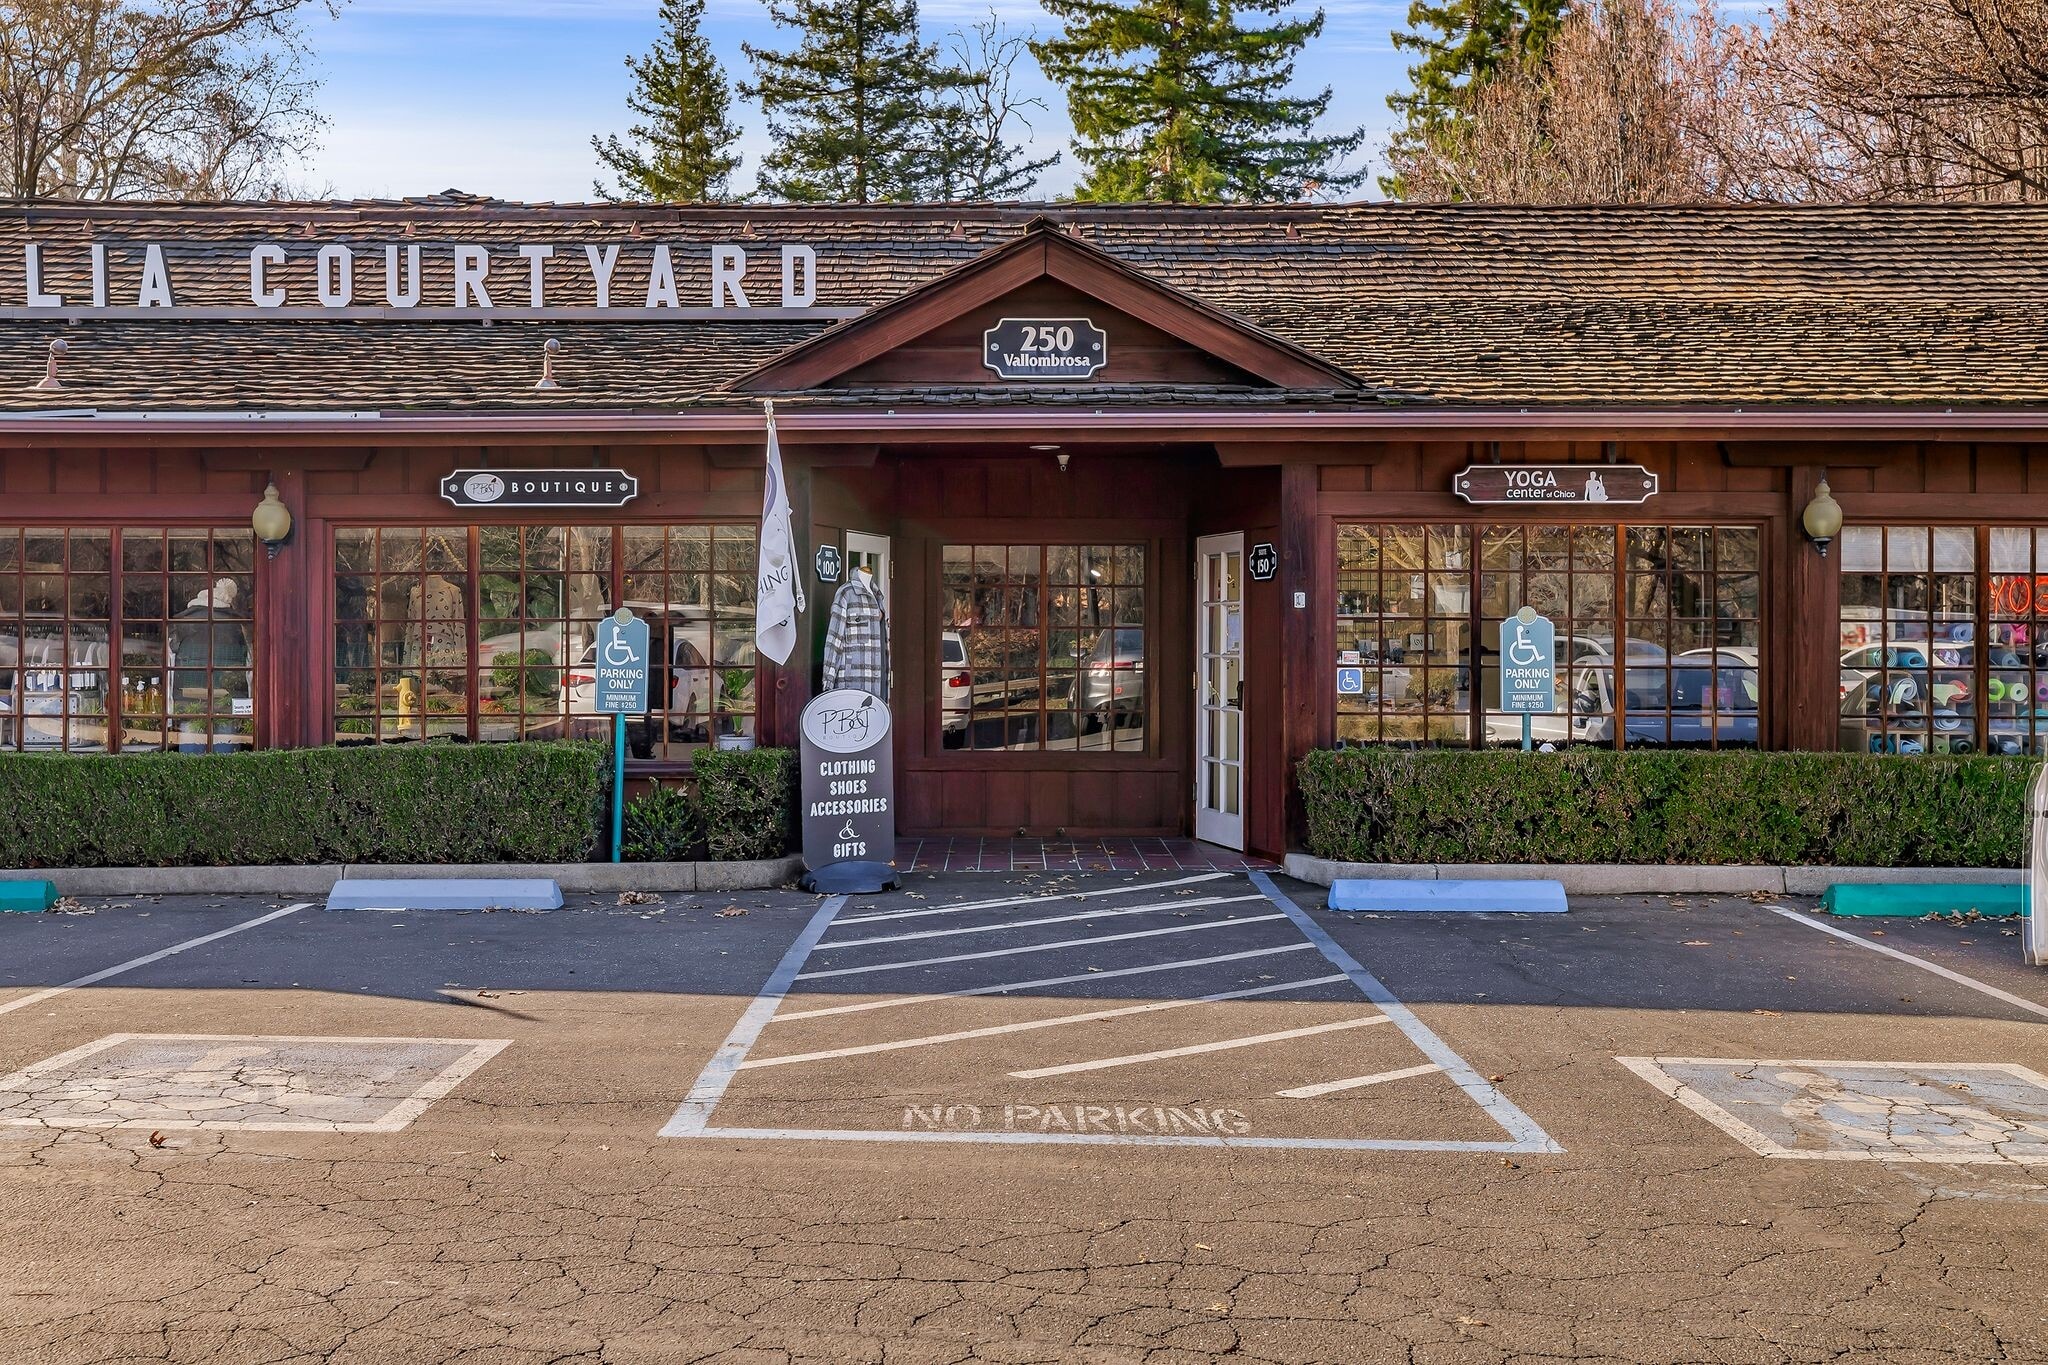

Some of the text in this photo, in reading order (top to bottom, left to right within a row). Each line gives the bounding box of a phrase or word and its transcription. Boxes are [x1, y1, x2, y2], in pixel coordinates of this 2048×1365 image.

[25, 244, 818, 309] LIA COURTYARD
[1020, 326, 1075, 352] 250
[1003, 353, 1091, 367] Vallombrosa
[1503, 470, 1557, 487] YOGA
[511, 481, 612, 494] BOUTIQUE
[1506, 487, 1547, 498] center
[1553, 490, 1576, 498] Chico
[822, 560, 835, 576] 100
[1257, 558, 1270, 573] 150
[600, 668, 643, 679] PARKING
[1505, 668, 1550, 678] PARKING
[609, 679, 634, 689] ONLY
[1514, 679, 1541, 689] ONLY
[605, 701, 637, 709] FINE $250
[606, 694, 636, 702] MINIMUM
[1511, 701, 1544, 709] FINE $250
[820, 759, 876, 776] CLOTHING
[829, 779, 867, 796] SHOES
[810, 797, 887, 817] ACCESSORIES
[838, 819, 860, 840] &
[833, 841, 867, 858] GIFTS
[902, 1103, 1250, 1134] NO PARKING
